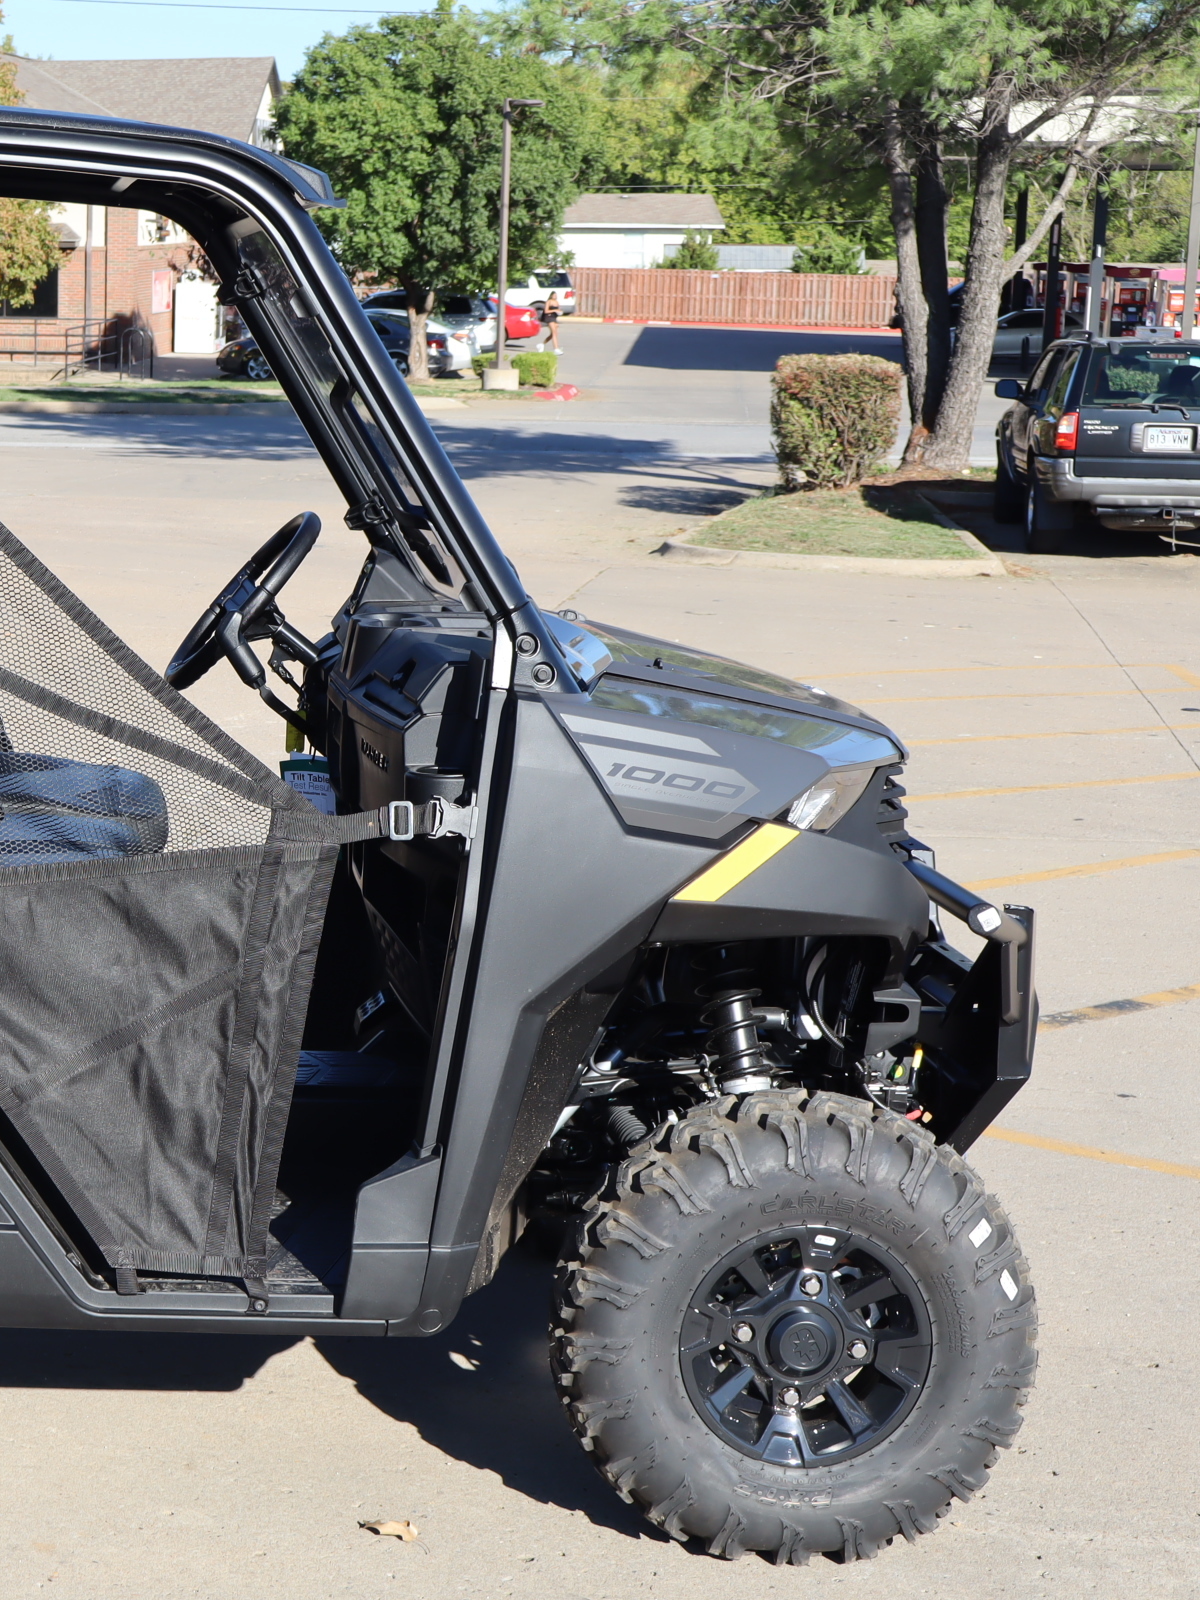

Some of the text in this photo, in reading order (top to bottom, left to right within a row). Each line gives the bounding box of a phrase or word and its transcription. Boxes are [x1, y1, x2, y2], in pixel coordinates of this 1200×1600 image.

[1149, 434, 1189, 445] 813 VNM
[290, 772, 330, 784] Tilt Table
[606, 762, 746, 799] 1000
[289, 780, 333, 792] Test Resul
[760, 1195, 907, 1236] CARLSTAR
